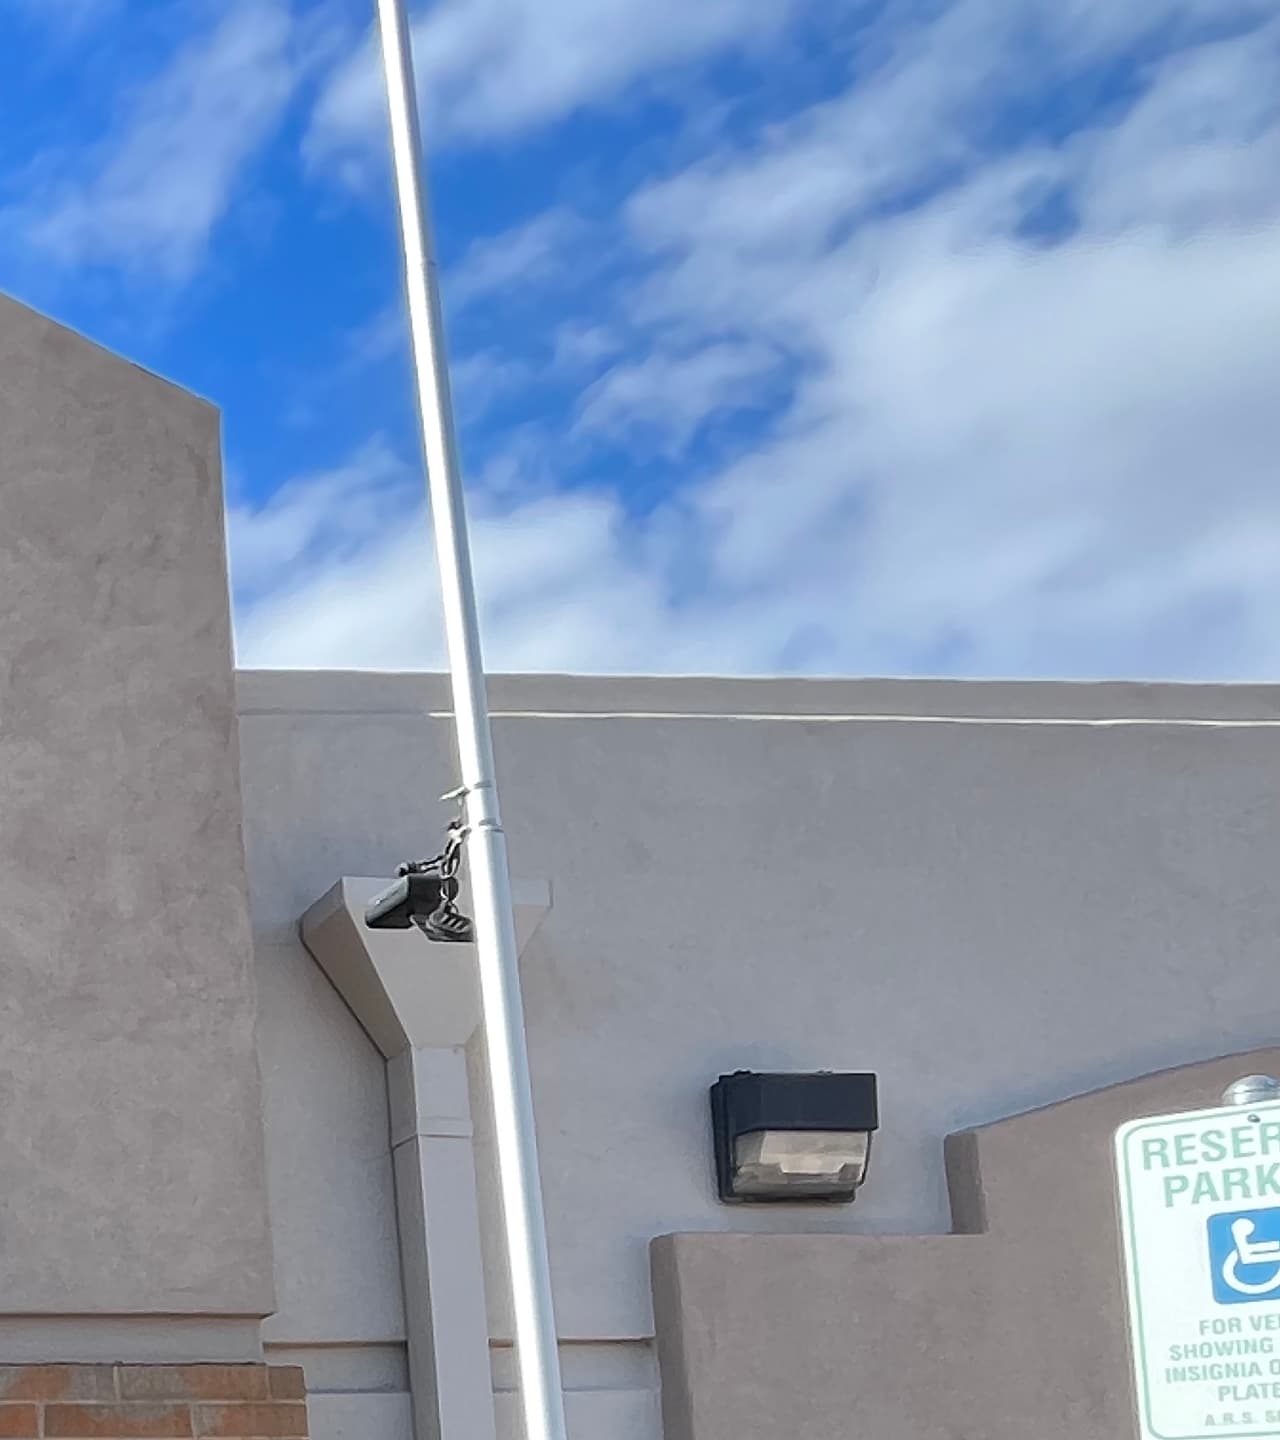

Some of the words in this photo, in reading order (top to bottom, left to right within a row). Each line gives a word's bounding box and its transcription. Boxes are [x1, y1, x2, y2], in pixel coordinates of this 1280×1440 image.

[1199, 1317, 1242, 1336] FOR
[1169, 1336, 1274, 1361] SHOWING
[1165, 1361, 1262, 1384] INSIGNIA
[1218, 1382, 1280, 1402] PLATE
